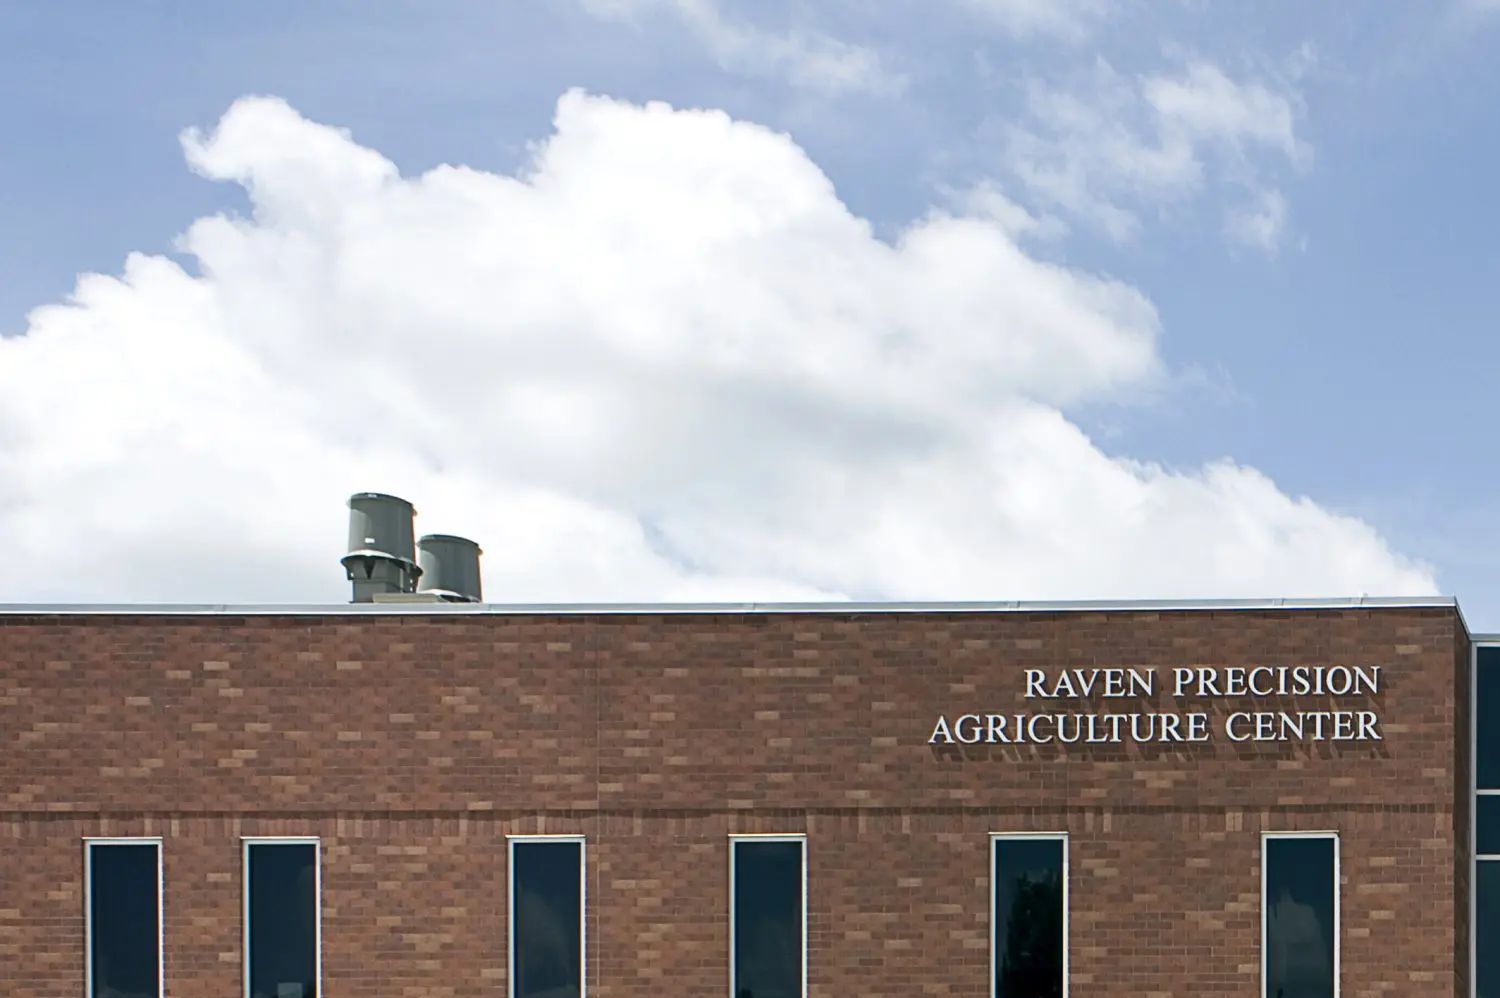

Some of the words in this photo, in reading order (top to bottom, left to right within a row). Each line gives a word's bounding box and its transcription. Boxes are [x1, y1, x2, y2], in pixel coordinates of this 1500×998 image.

[1022, 668, 1154, 698] RAVEN
[1172, 665, 1380, 696] PRECISION
[927, 712, 1209, 744] AGRICULTURE
[1225, 711, 1382, 742] CENTER
